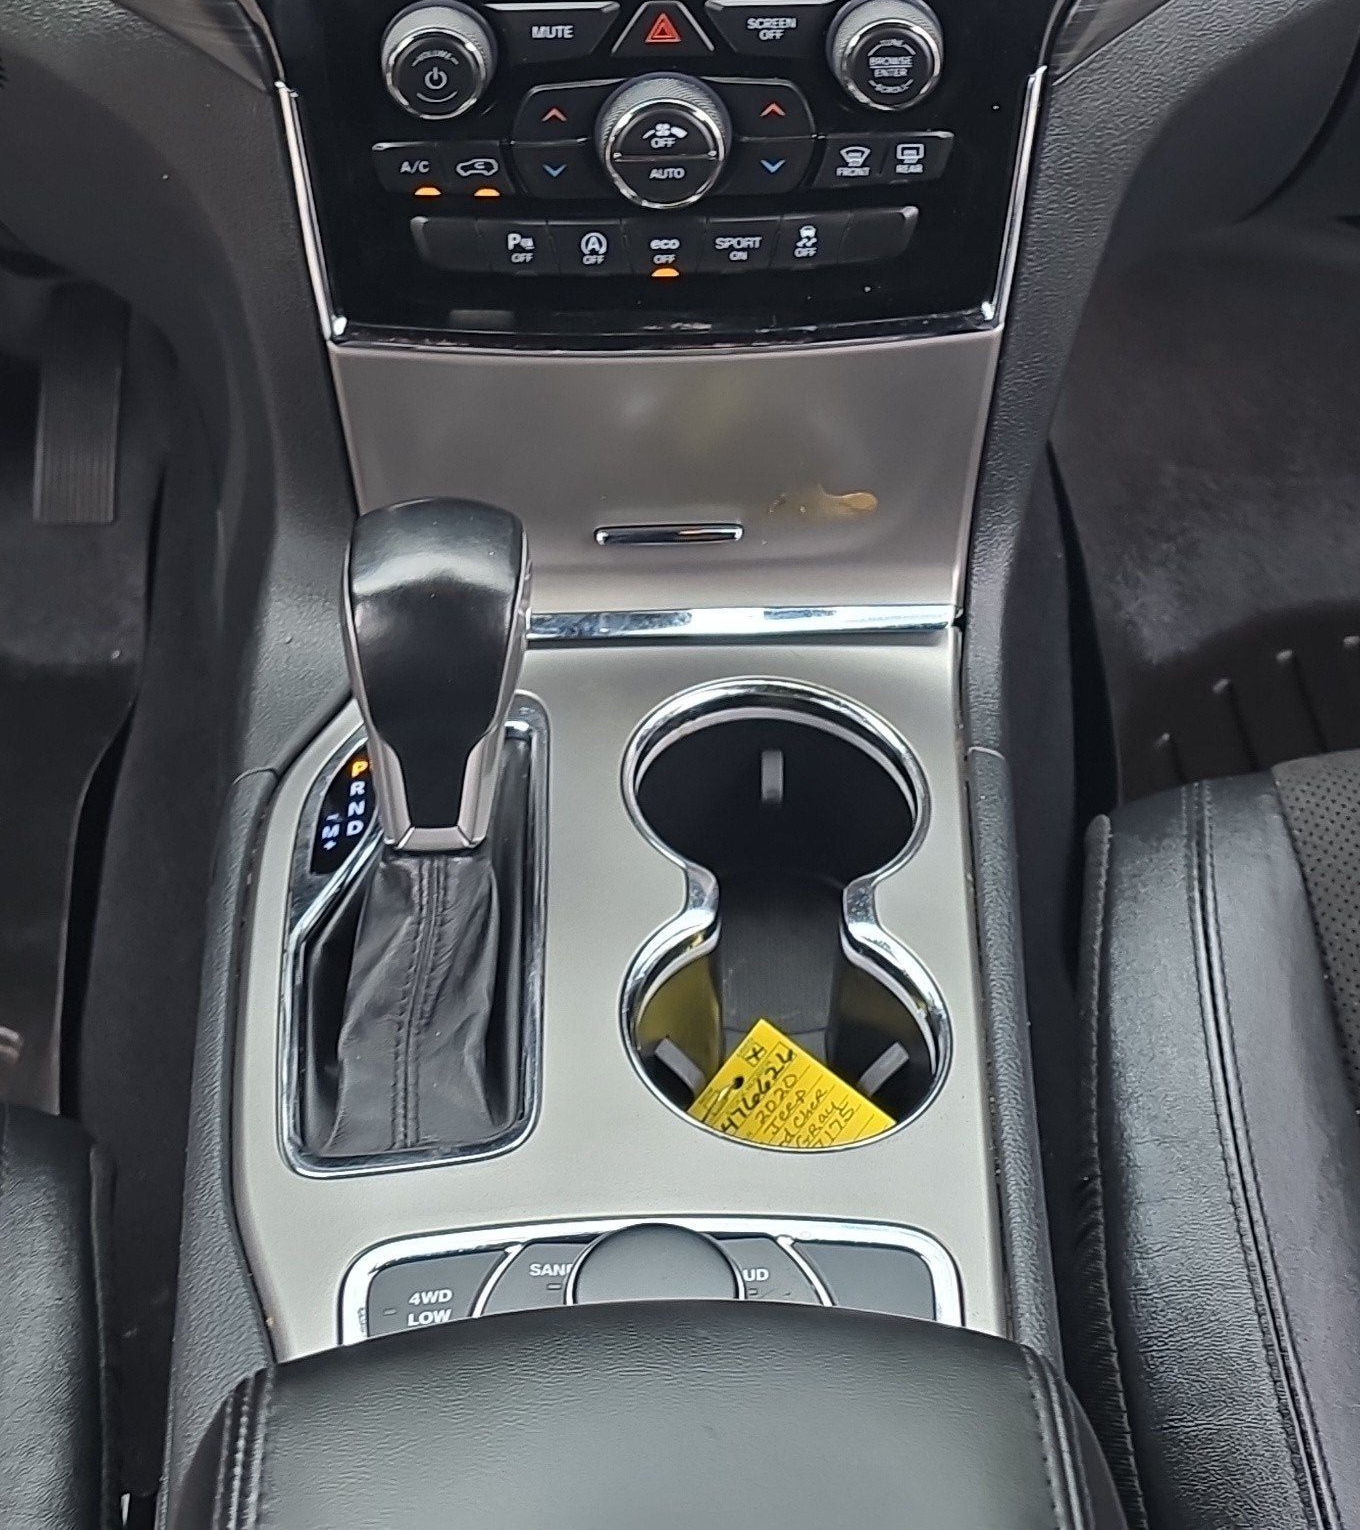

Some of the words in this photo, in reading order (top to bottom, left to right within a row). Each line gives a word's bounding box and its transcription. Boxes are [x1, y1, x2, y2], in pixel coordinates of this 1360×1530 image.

[747, 17, 797, 29] SCREEN
[531, 25, 575, 39] MUTE
[759, 29, 784, 41] OFF
[650, 137, 676, 149] OFF
[400, 160, 430, 173] A/C
[836, 166, 871, 177] FRONT
[896, 163, 924, 174] REAR
[649, 167, 685, 180] AUTO
[650, 238, 680, 250] eco
[715, 236, 762, 250] SPORT
[510, 252, 534, 264] OFF
[653, 253, 676, 264] OFF
[729, 250, 748, 262] ON
[794, 246, 817, 258] OFF
[582, 254, 605, 265] OFF
[351, 760, 369, 778] P
[350, 780, 366, 797] R
[347, 799, 366, 817] N
[321, 823, 340, 841] M
[346, 819, 364, 837] D
[755, 1073, 799, 1125] 2020
[408, 1289, 453, 1306] 4WD
[407, 1308, 452, 1326] LOW
